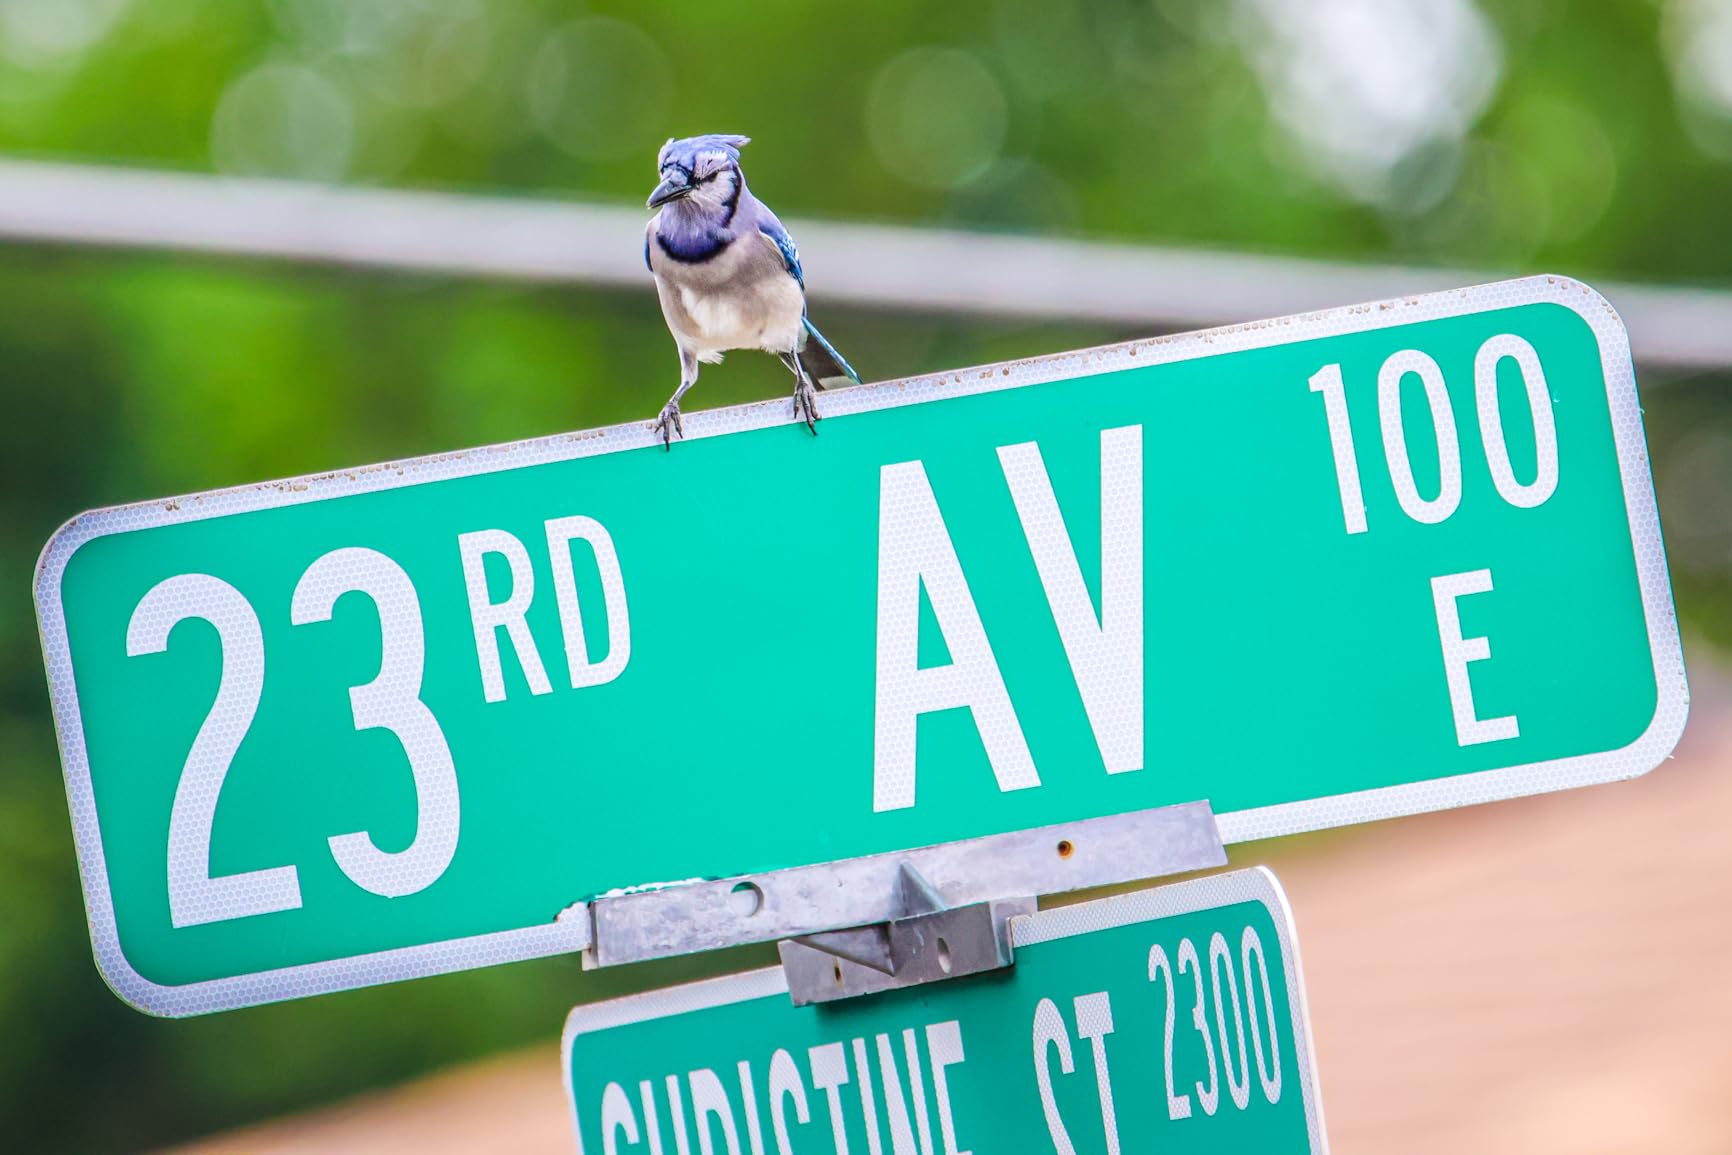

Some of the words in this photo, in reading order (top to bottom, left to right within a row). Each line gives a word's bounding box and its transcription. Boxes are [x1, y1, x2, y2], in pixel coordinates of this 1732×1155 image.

[873, 424, 1144, 812] AV
[1308, 333, 1559, 534] 100
[1430, 569, 1519, 747] E
[1033, 991, 1120, 1155] ST
[1147, 926, 1282, 1121] 2300
